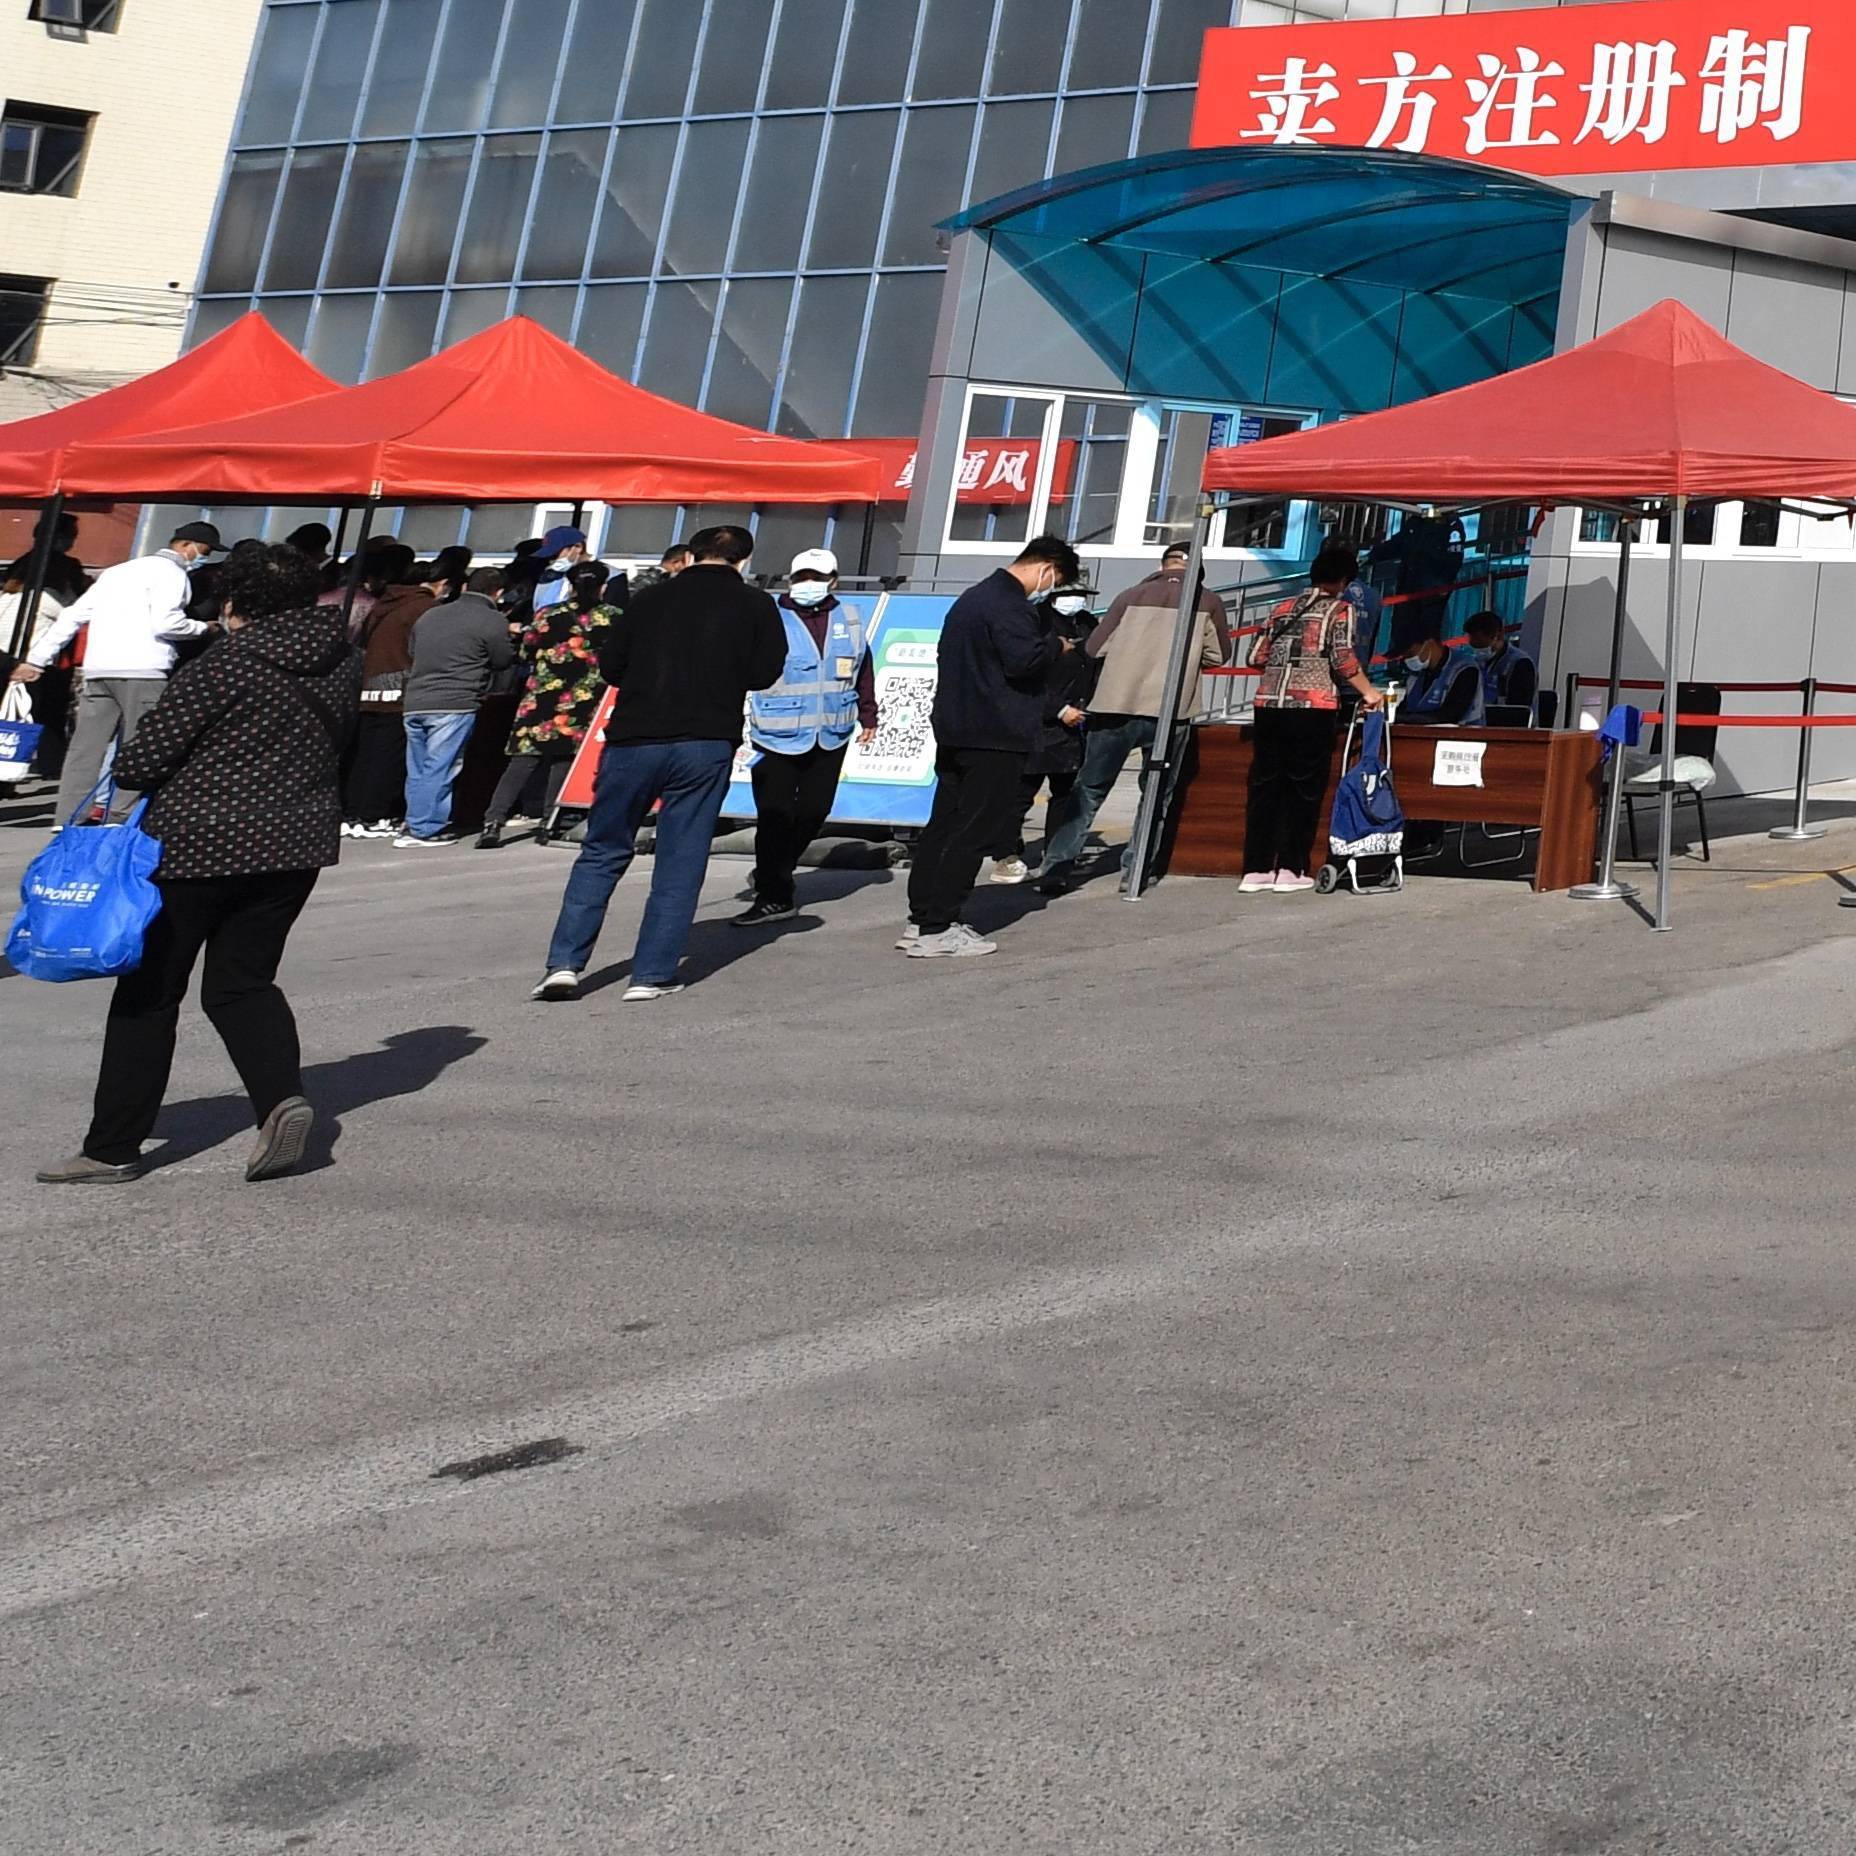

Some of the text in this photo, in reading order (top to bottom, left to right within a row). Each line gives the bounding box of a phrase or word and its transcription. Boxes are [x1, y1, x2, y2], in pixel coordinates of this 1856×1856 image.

[1238, 24, 1813, 156] 卖方注册制
